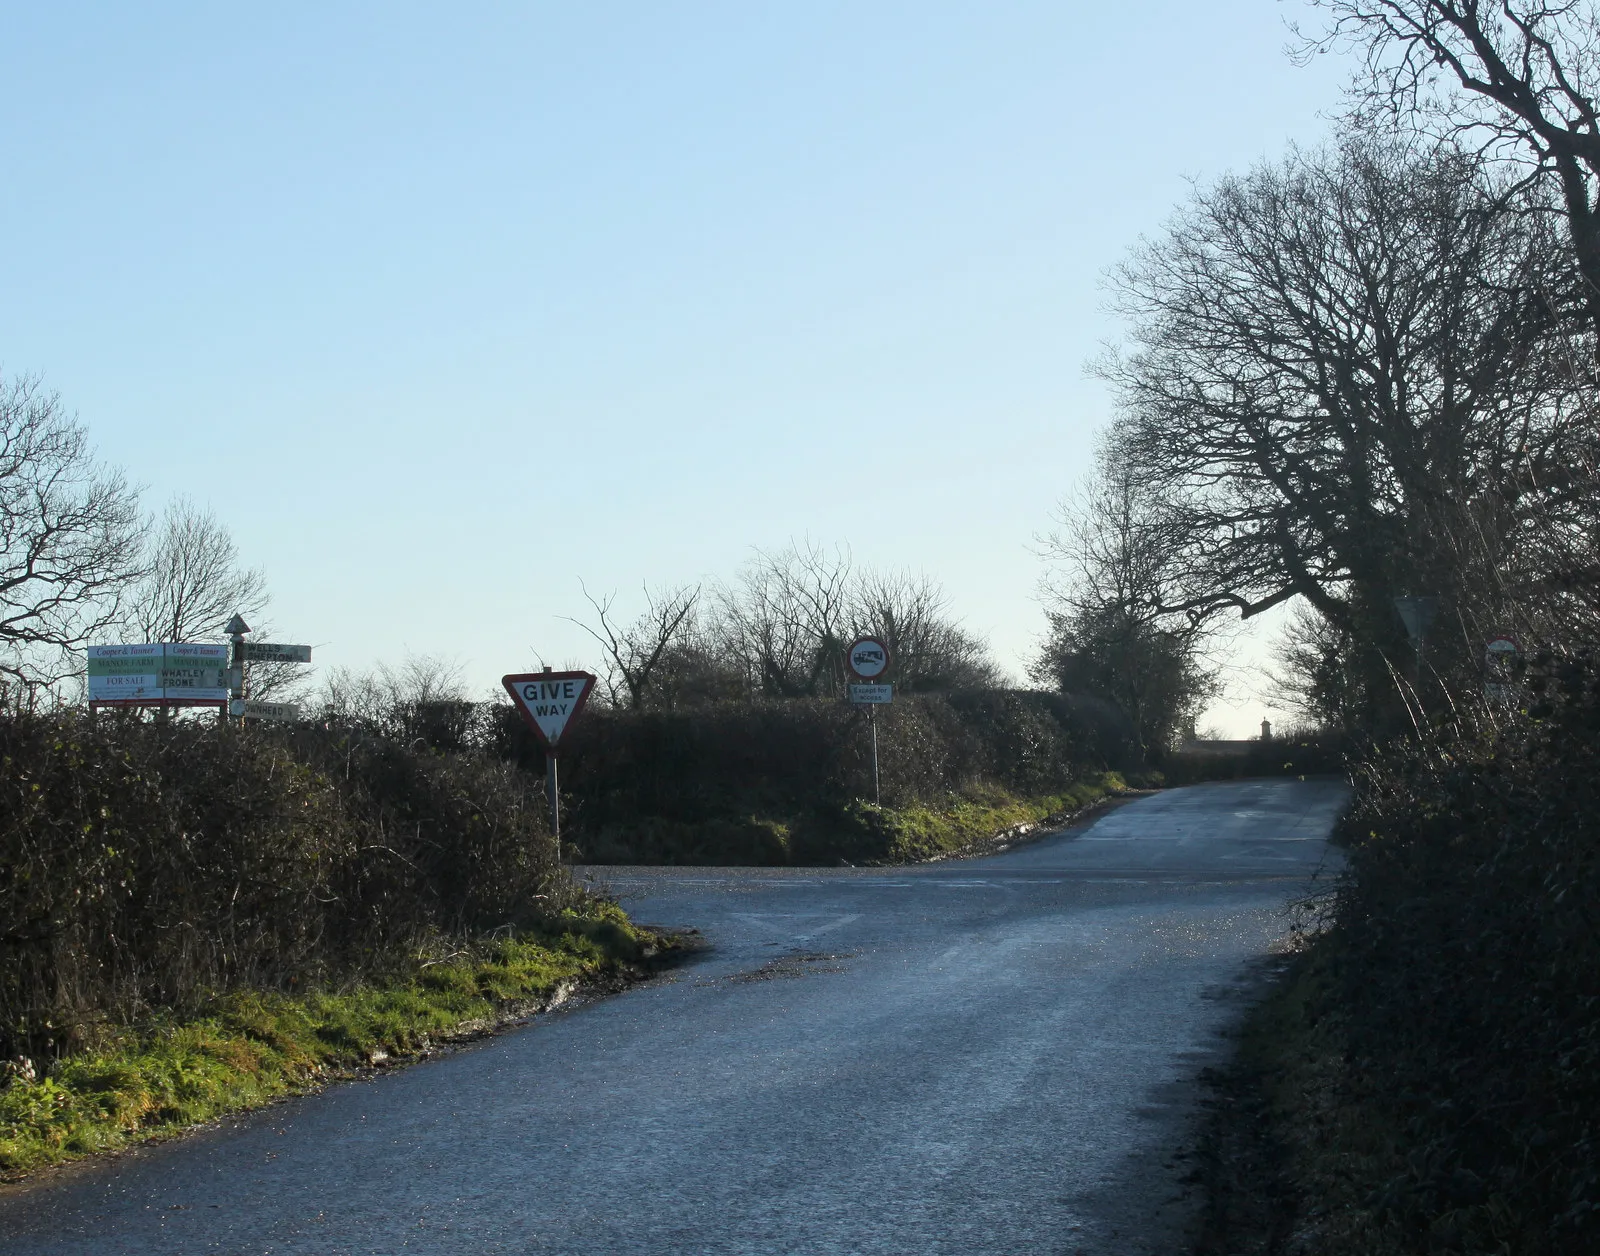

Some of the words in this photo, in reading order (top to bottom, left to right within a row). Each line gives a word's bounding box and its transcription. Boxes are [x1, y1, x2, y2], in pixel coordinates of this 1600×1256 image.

[97, 647, 120, 657] Cooper
[130, 646, 155, 654] Tanner
[173, 646, 192, 655] Cooper
[200, 647, 219, 655] Tanner
[248, 643, 280, 652] WELLS
[247, 652, 292, 661] SHEPTON
[98, 658, 129, 667] MANOR
[131, 657, 154, 666] FARM
[161, 669, 205, 678] WHATLEY
[106, 677, 123, 685] FOR
[125, 676, 145, 684] SALE
[163, 679, 194, 687] FROME
[523, 682, 575, 701] GIVE
[245, 703, 283, 716] OWNHEAD
[536, 704, 568, 717] WAY
